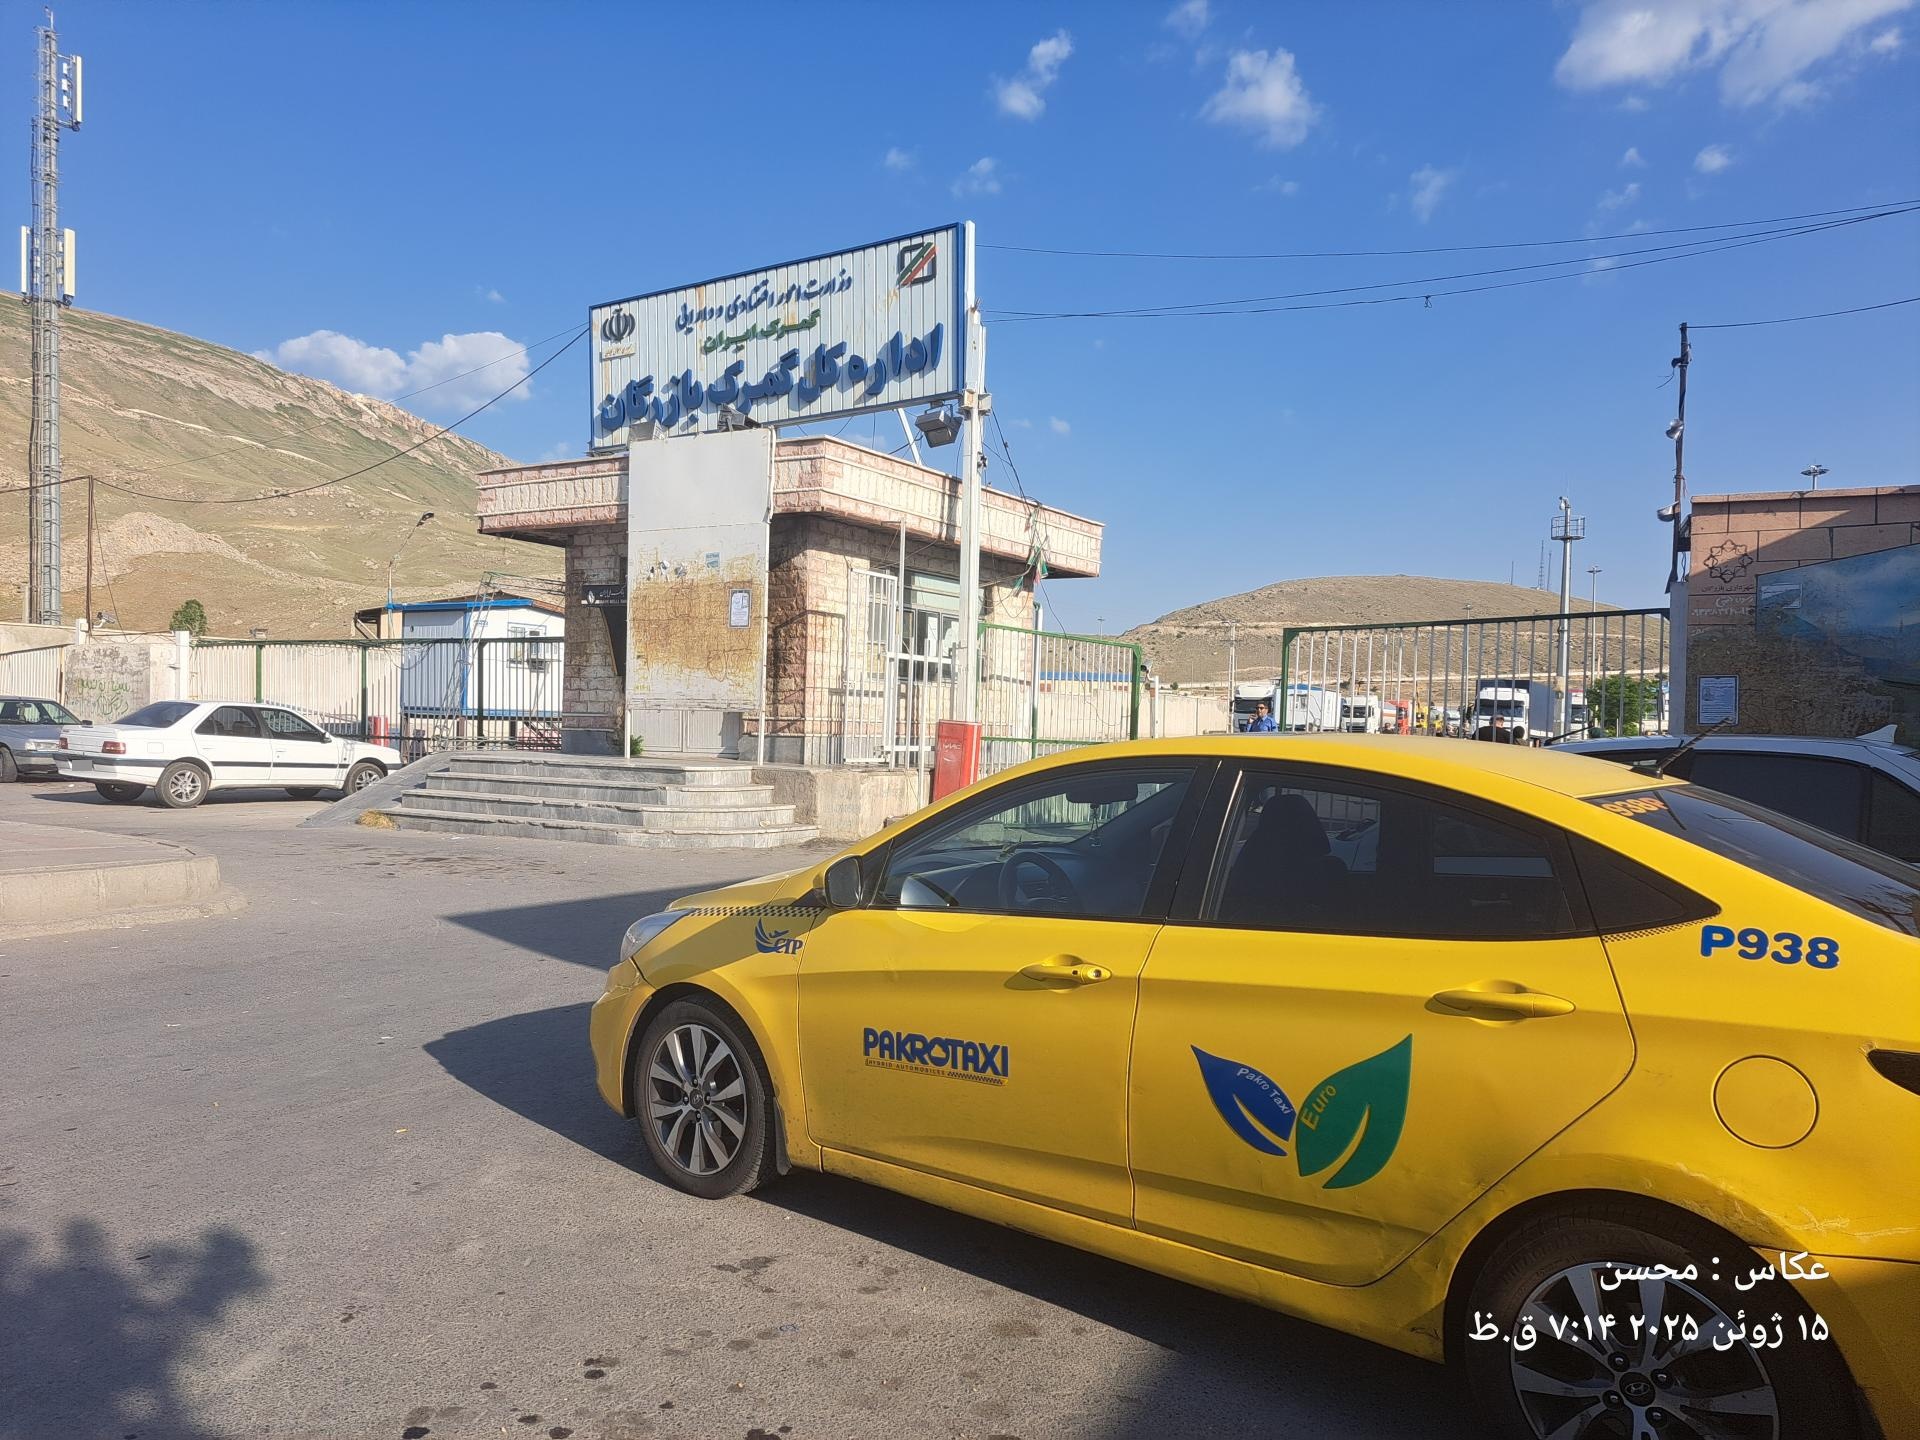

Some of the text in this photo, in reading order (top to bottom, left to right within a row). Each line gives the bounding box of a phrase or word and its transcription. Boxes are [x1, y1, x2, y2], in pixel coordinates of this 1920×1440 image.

[803, 268, 852, 300] وزارت
[703, 323, 758, 354] ایران
[601, 322, 944, 431] اداره کل گمرک بازرگان
[1700, 925, 1840, 969] P938
[863, 1027, 1009, 1078] PAKROTAXI
[867, 1059, 945, 1076] HYBRID AUTOMOBILES
[1236, 1067, 1294, 1115] Pakro Taxi
[1300, 1084, 1338, 1131] Euro
